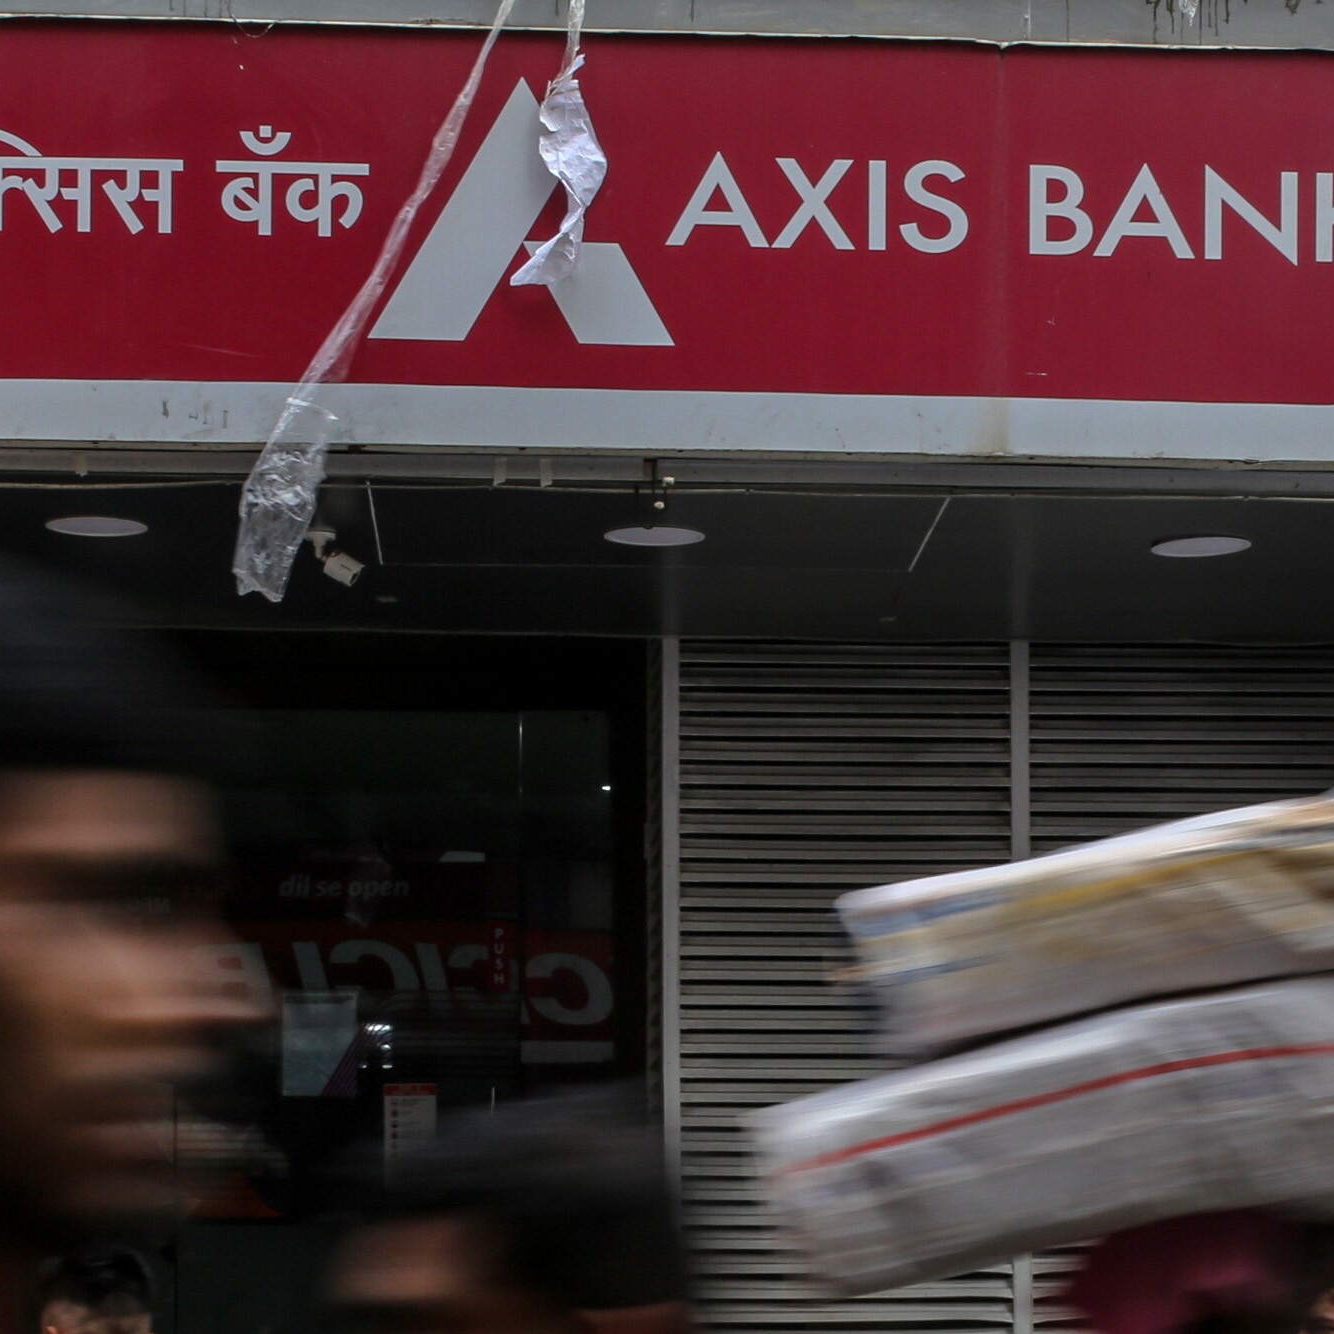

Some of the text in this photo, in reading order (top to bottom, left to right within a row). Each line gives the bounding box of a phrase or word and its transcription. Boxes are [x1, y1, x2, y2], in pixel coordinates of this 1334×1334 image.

[665, 150, 969, 254] AXIS
[315, 879, 342, 897] se
[347, 879, 410, 902] open
[493, 927, 505, 985] PUSH
